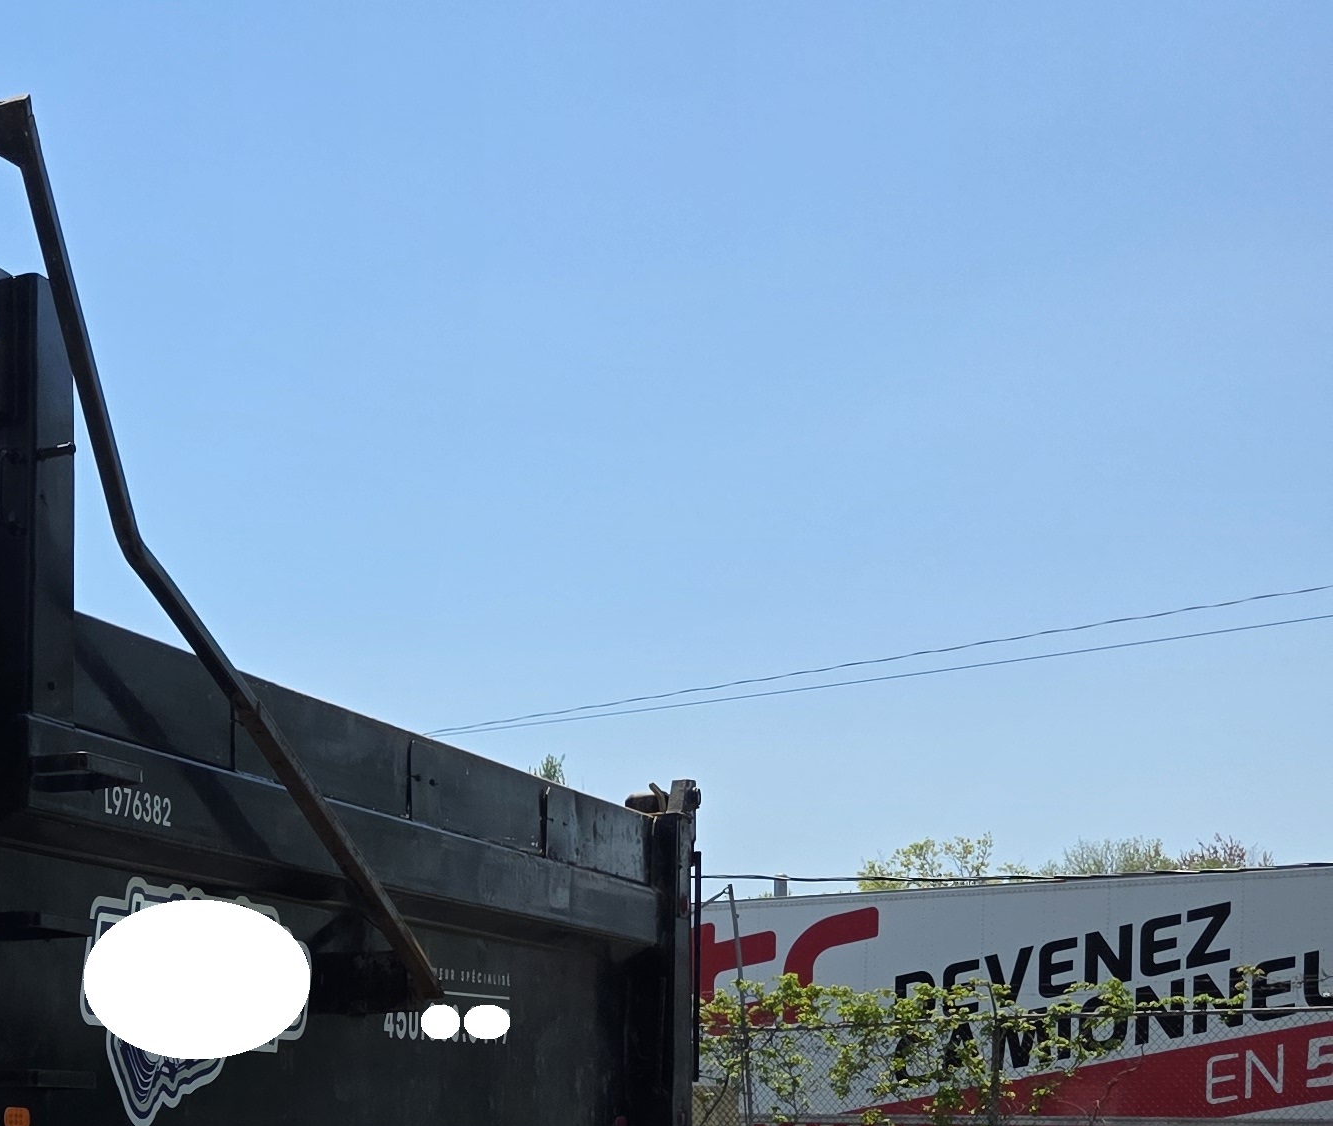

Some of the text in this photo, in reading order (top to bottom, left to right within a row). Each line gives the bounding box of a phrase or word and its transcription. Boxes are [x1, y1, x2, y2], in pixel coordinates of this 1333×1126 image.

[104, 786, 172, 828] L976382
[894, 900, 1232, 1021] DEVENEZ
[1205, 1043, 1284, 1105] EN
